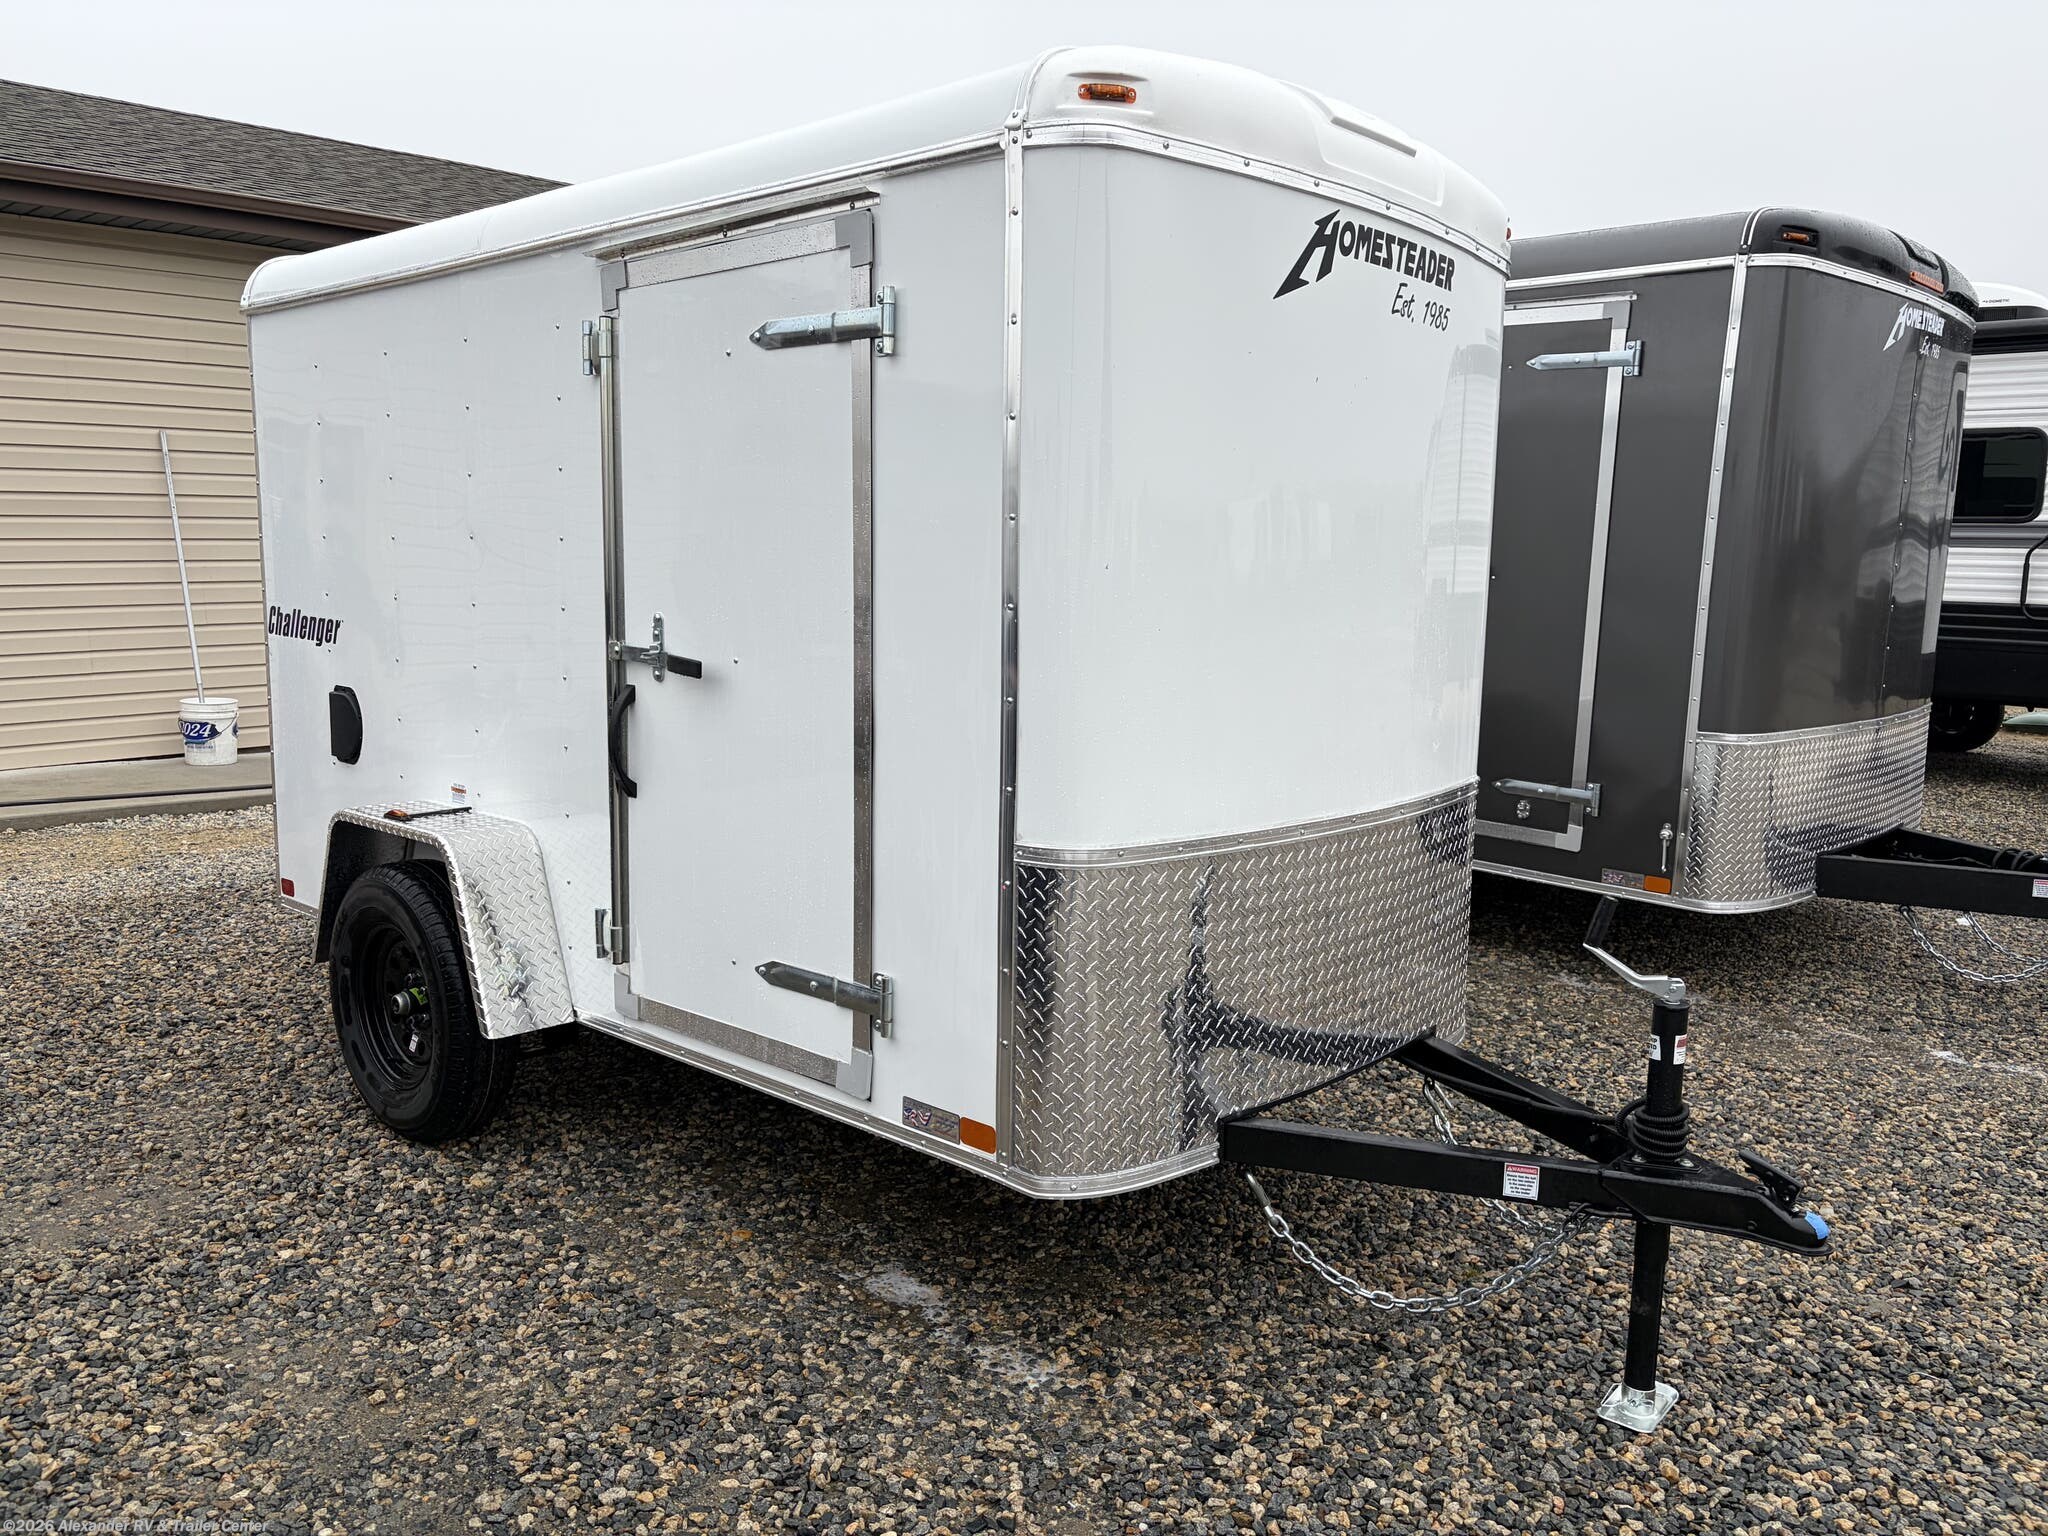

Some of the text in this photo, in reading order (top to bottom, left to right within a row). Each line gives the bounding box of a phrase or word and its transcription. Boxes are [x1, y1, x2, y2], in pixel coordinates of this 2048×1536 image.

[1273, 209, 1455, 300] HOMESTEADER
[1423, 301, 1451, 331] 1985
[1882, 302, 1946, 351] HOMESTEADER
[268, 605, 341, 647] Challenger
